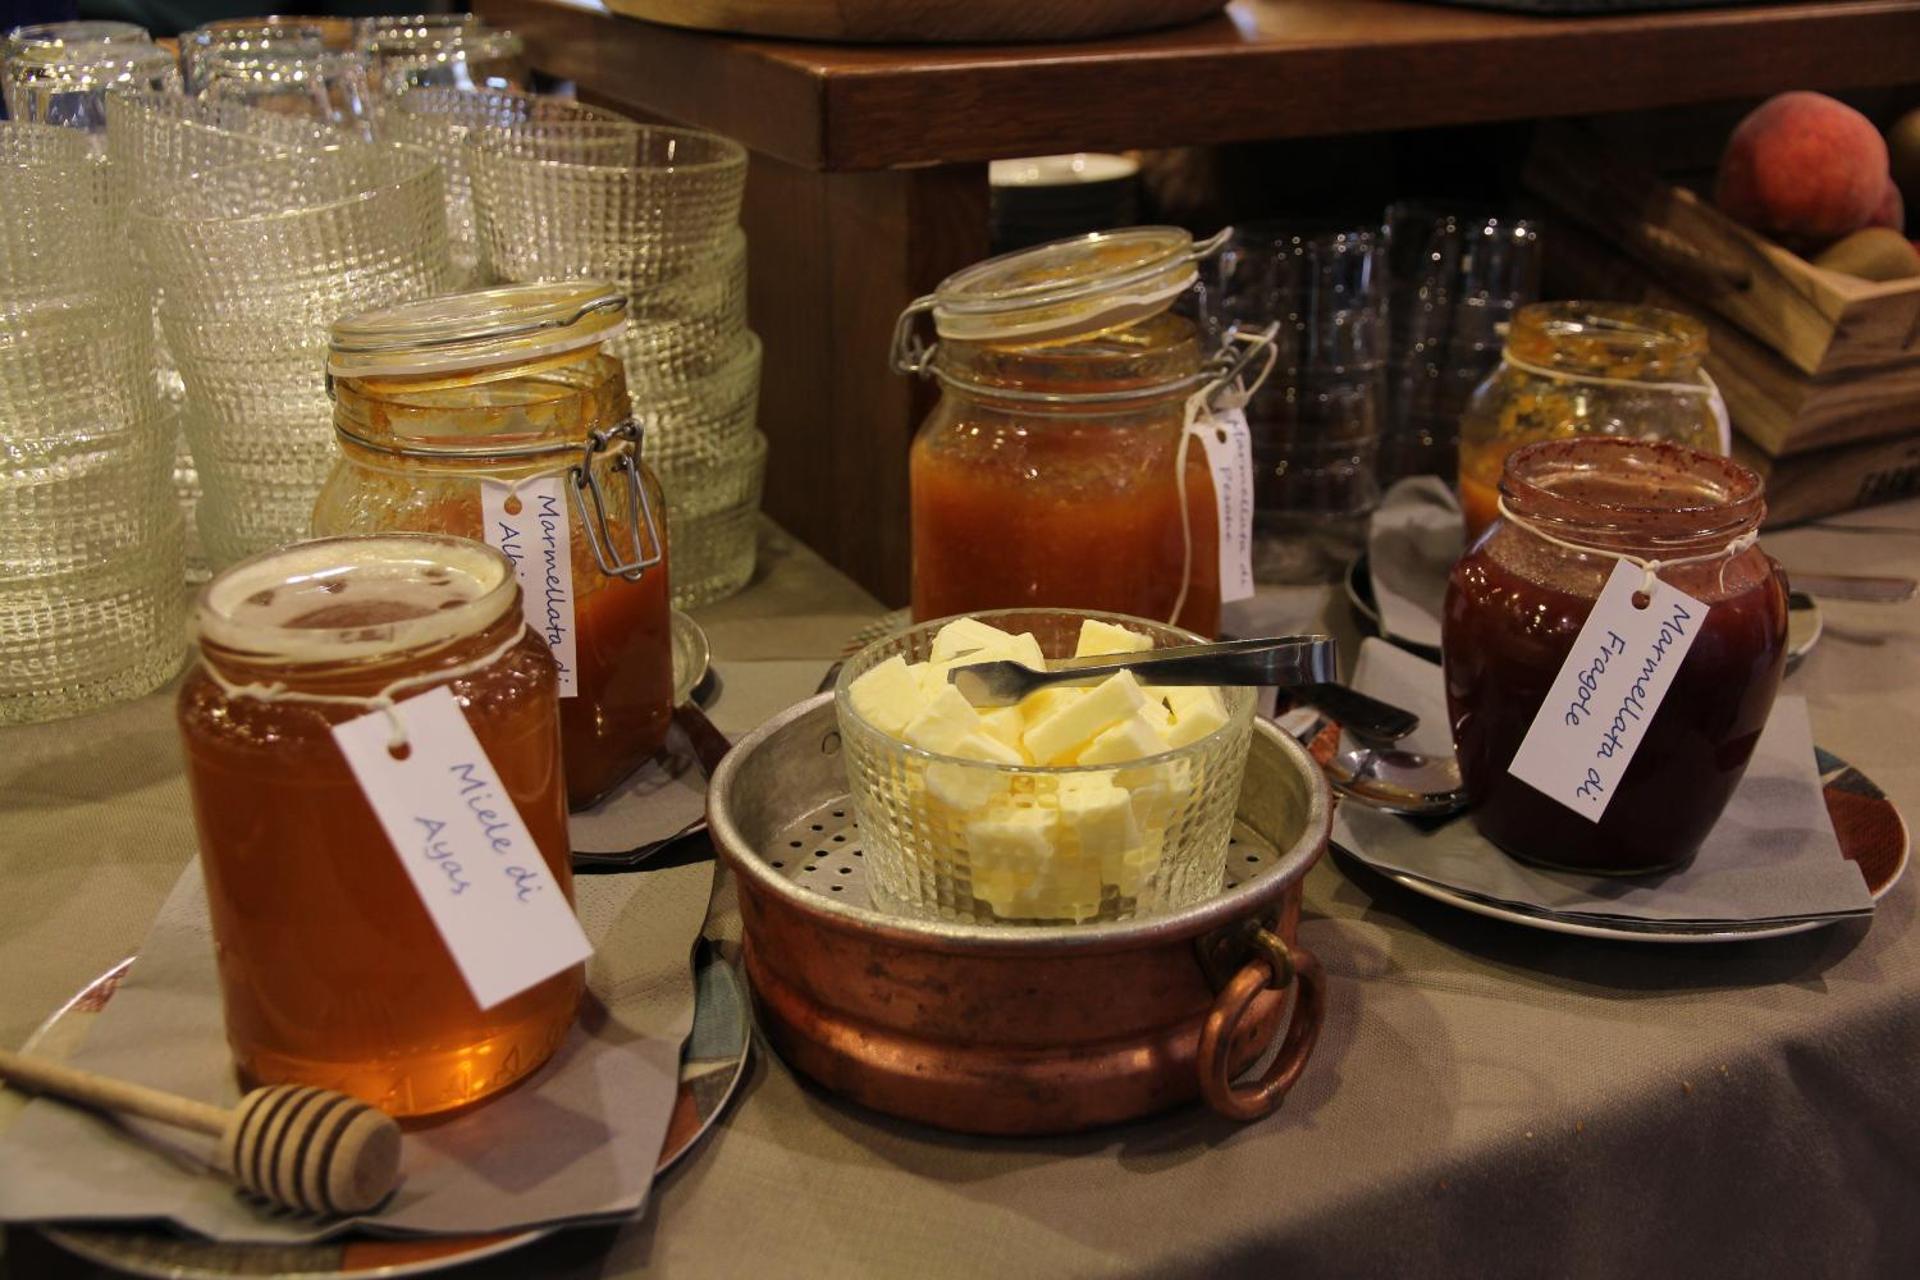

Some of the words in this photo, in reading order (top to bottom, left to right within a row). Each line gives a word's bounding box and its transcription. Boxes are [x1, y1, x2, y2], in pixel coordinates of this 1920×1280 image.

[537, 494, 567, 649] Marmellata
[1565, 630, 1627, 727] Fragole
[1596, 603, 1692, 759] Marmellata
[450, 762, 512, 855] Miele
[505, 864, 544, 904] di
[1576, 767, 1605, 802] di
[413, 816, 472, 897] Ayas
